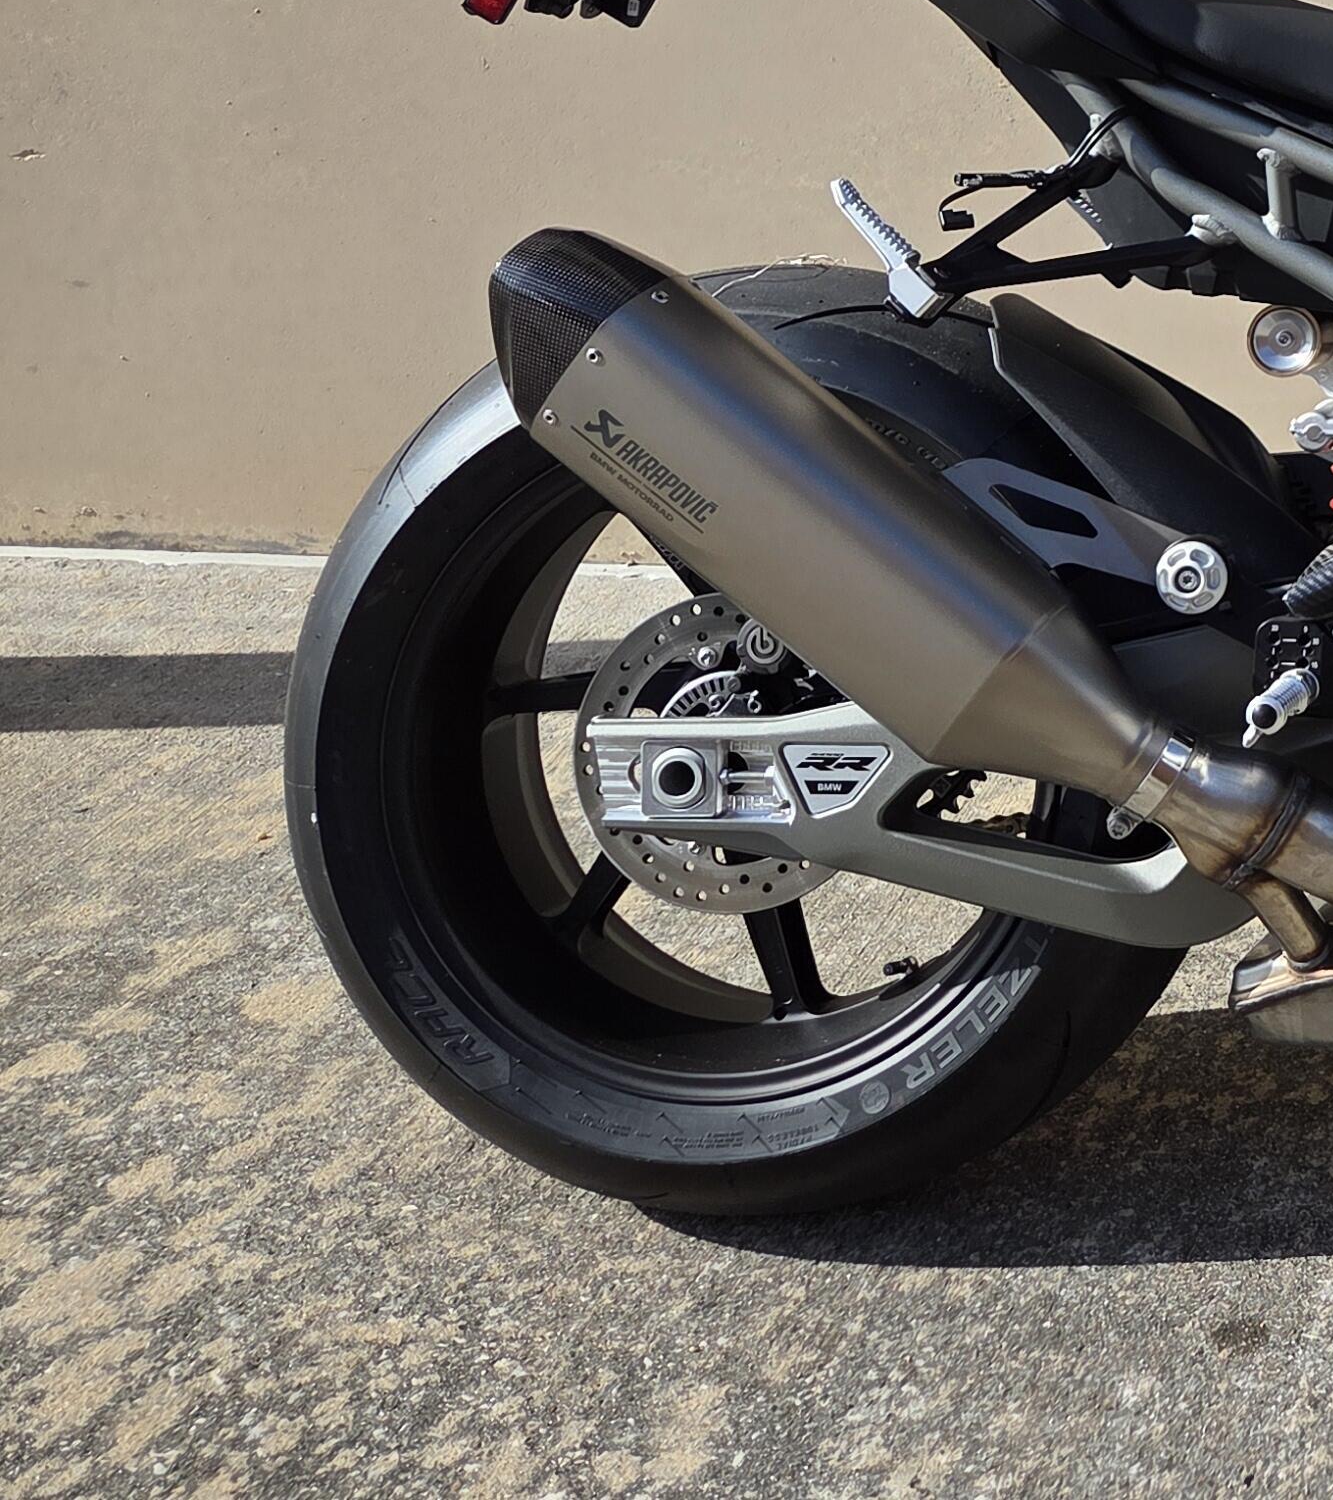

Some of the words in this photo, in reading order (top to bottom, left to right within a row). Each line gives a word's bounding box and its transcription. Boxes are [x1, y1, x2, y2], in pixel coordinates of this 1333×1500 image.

[589, 451, 617, 476] BMW
[616, 473, 674, 522] MOTORRAD
[795, 756, 878, 772] RR
[817, 783, 842, 792] BMW
